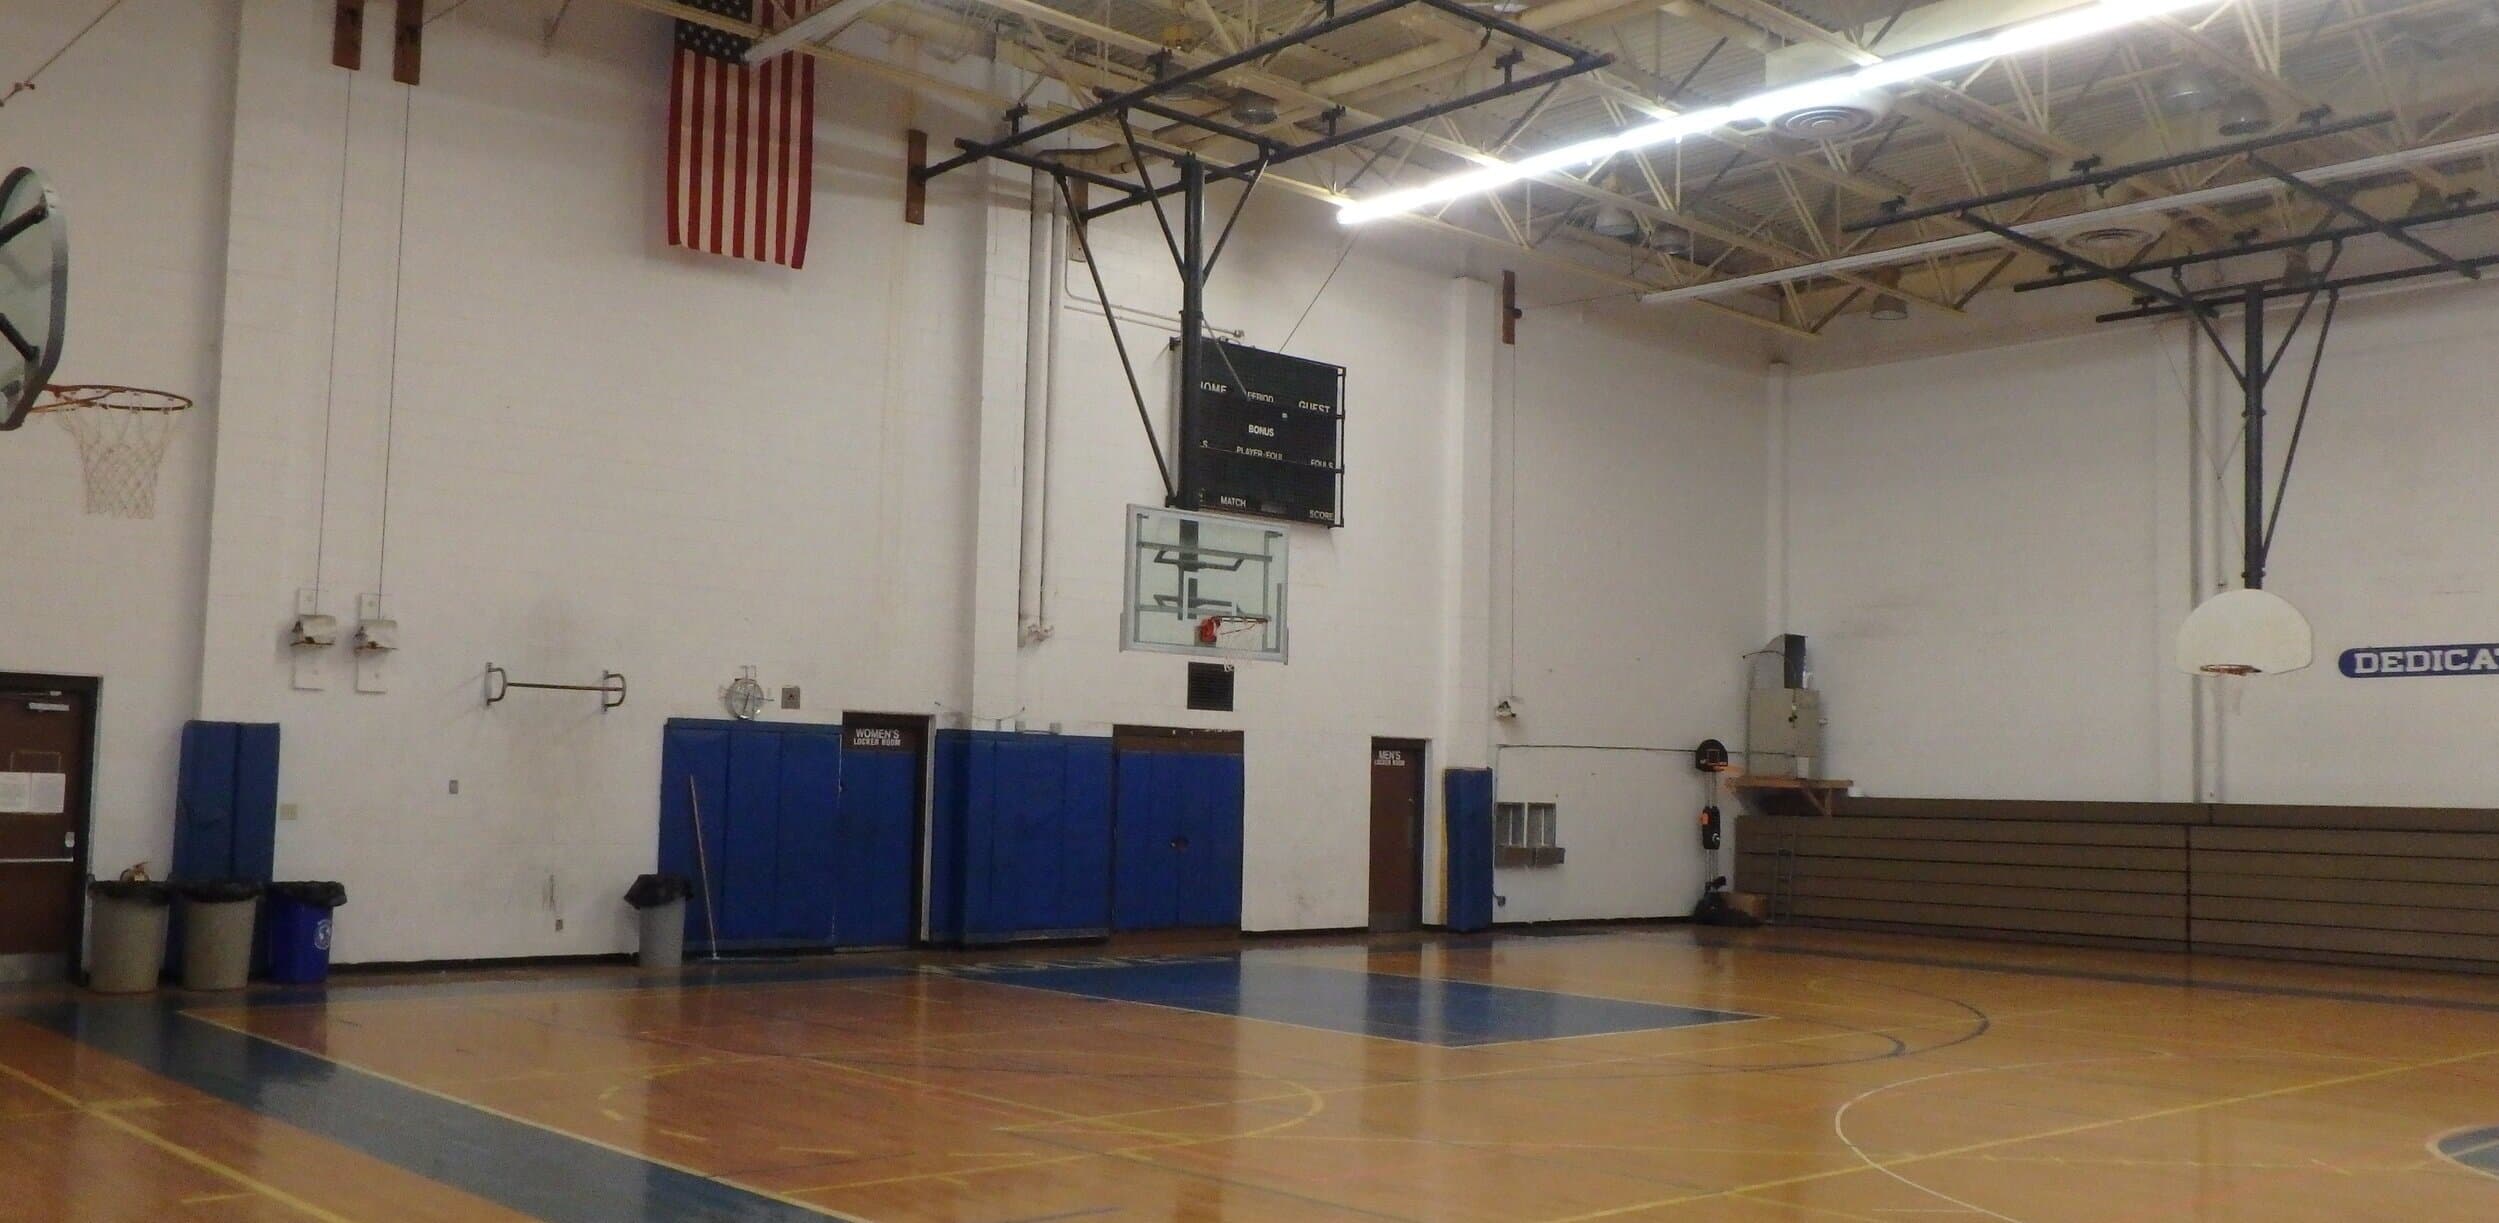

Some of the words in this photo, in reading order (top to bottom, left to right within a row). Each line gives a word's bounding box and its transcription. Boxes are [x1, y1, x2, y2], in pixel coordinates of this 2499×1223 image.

[1248, 424, 1274, 437] BONUS
[1220, 495, 1246, 508] MATCH
[1309, 509, 1334, 521] SCORE
[855, 728, 900, 739] WOMEN'S
